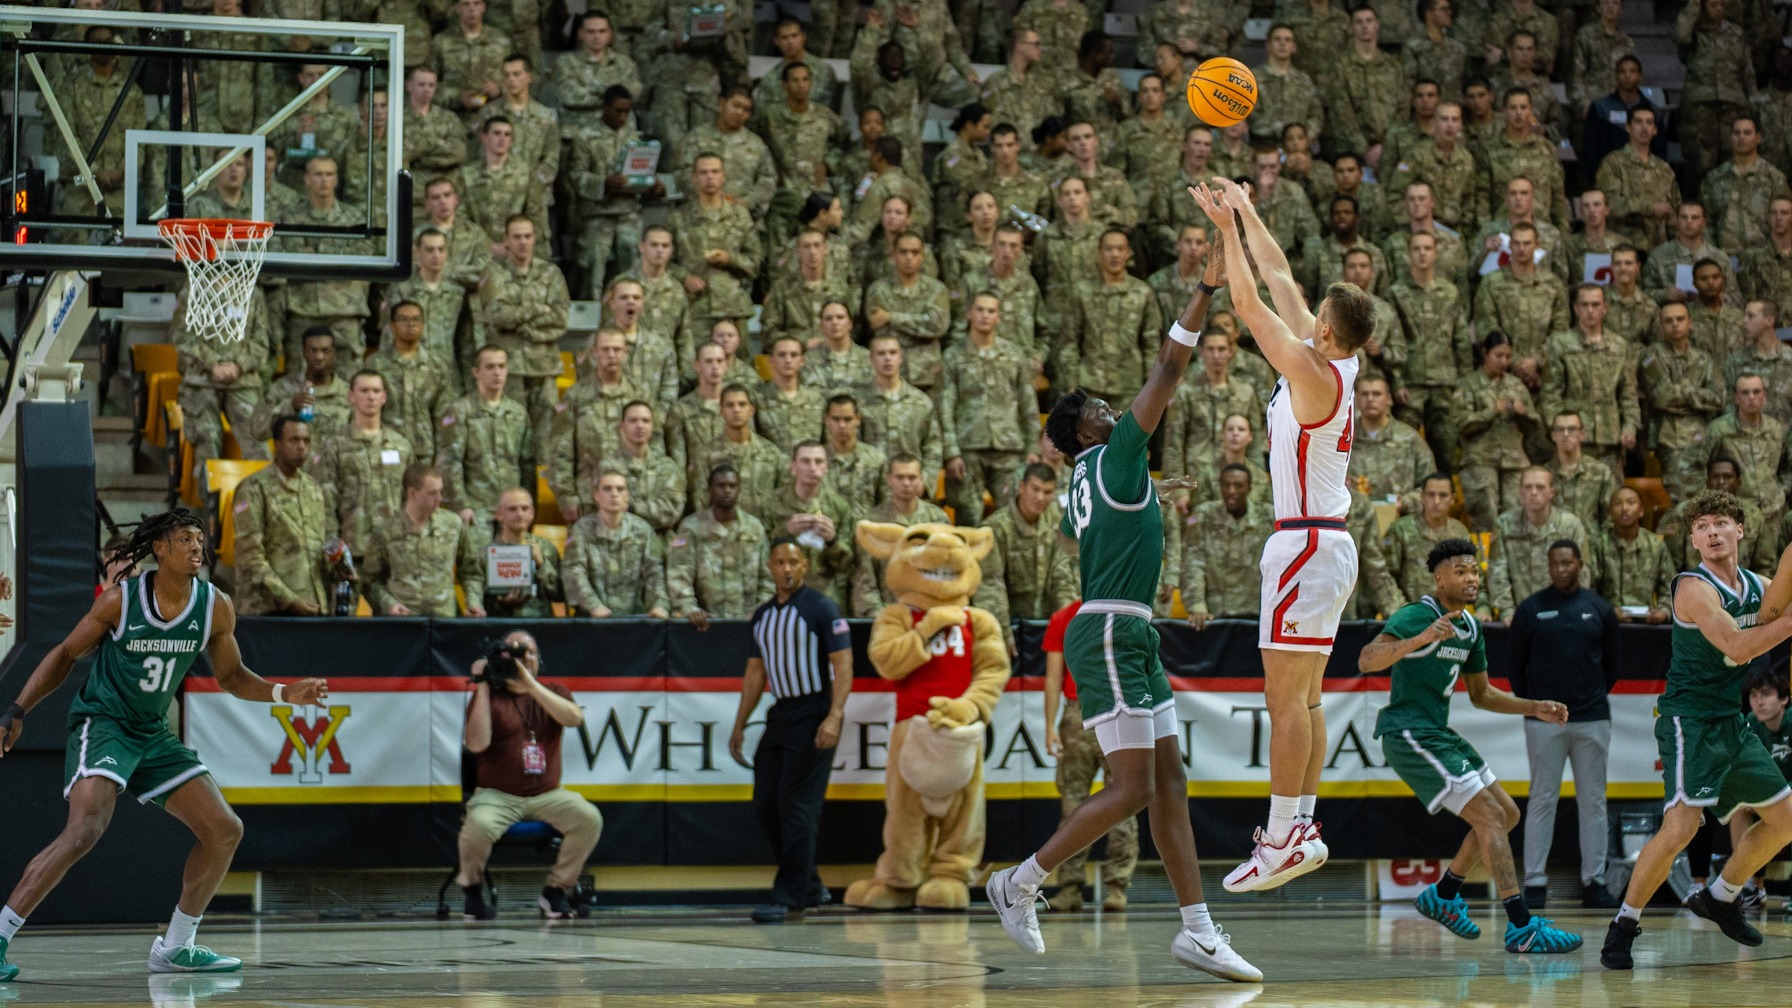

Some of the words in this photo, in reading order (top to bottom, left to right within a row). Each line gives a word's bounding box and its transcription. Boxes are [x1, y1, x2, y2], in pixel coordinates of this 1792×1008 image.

[1228, 73, 1254, 94] NCAA
[1213, 89, 1250, 116] Wilson
[126, 639, 198, 653] JACKSONVILLE
[138, 656, 177, 693] 31
[1443, 663, 1460, 697] 2
